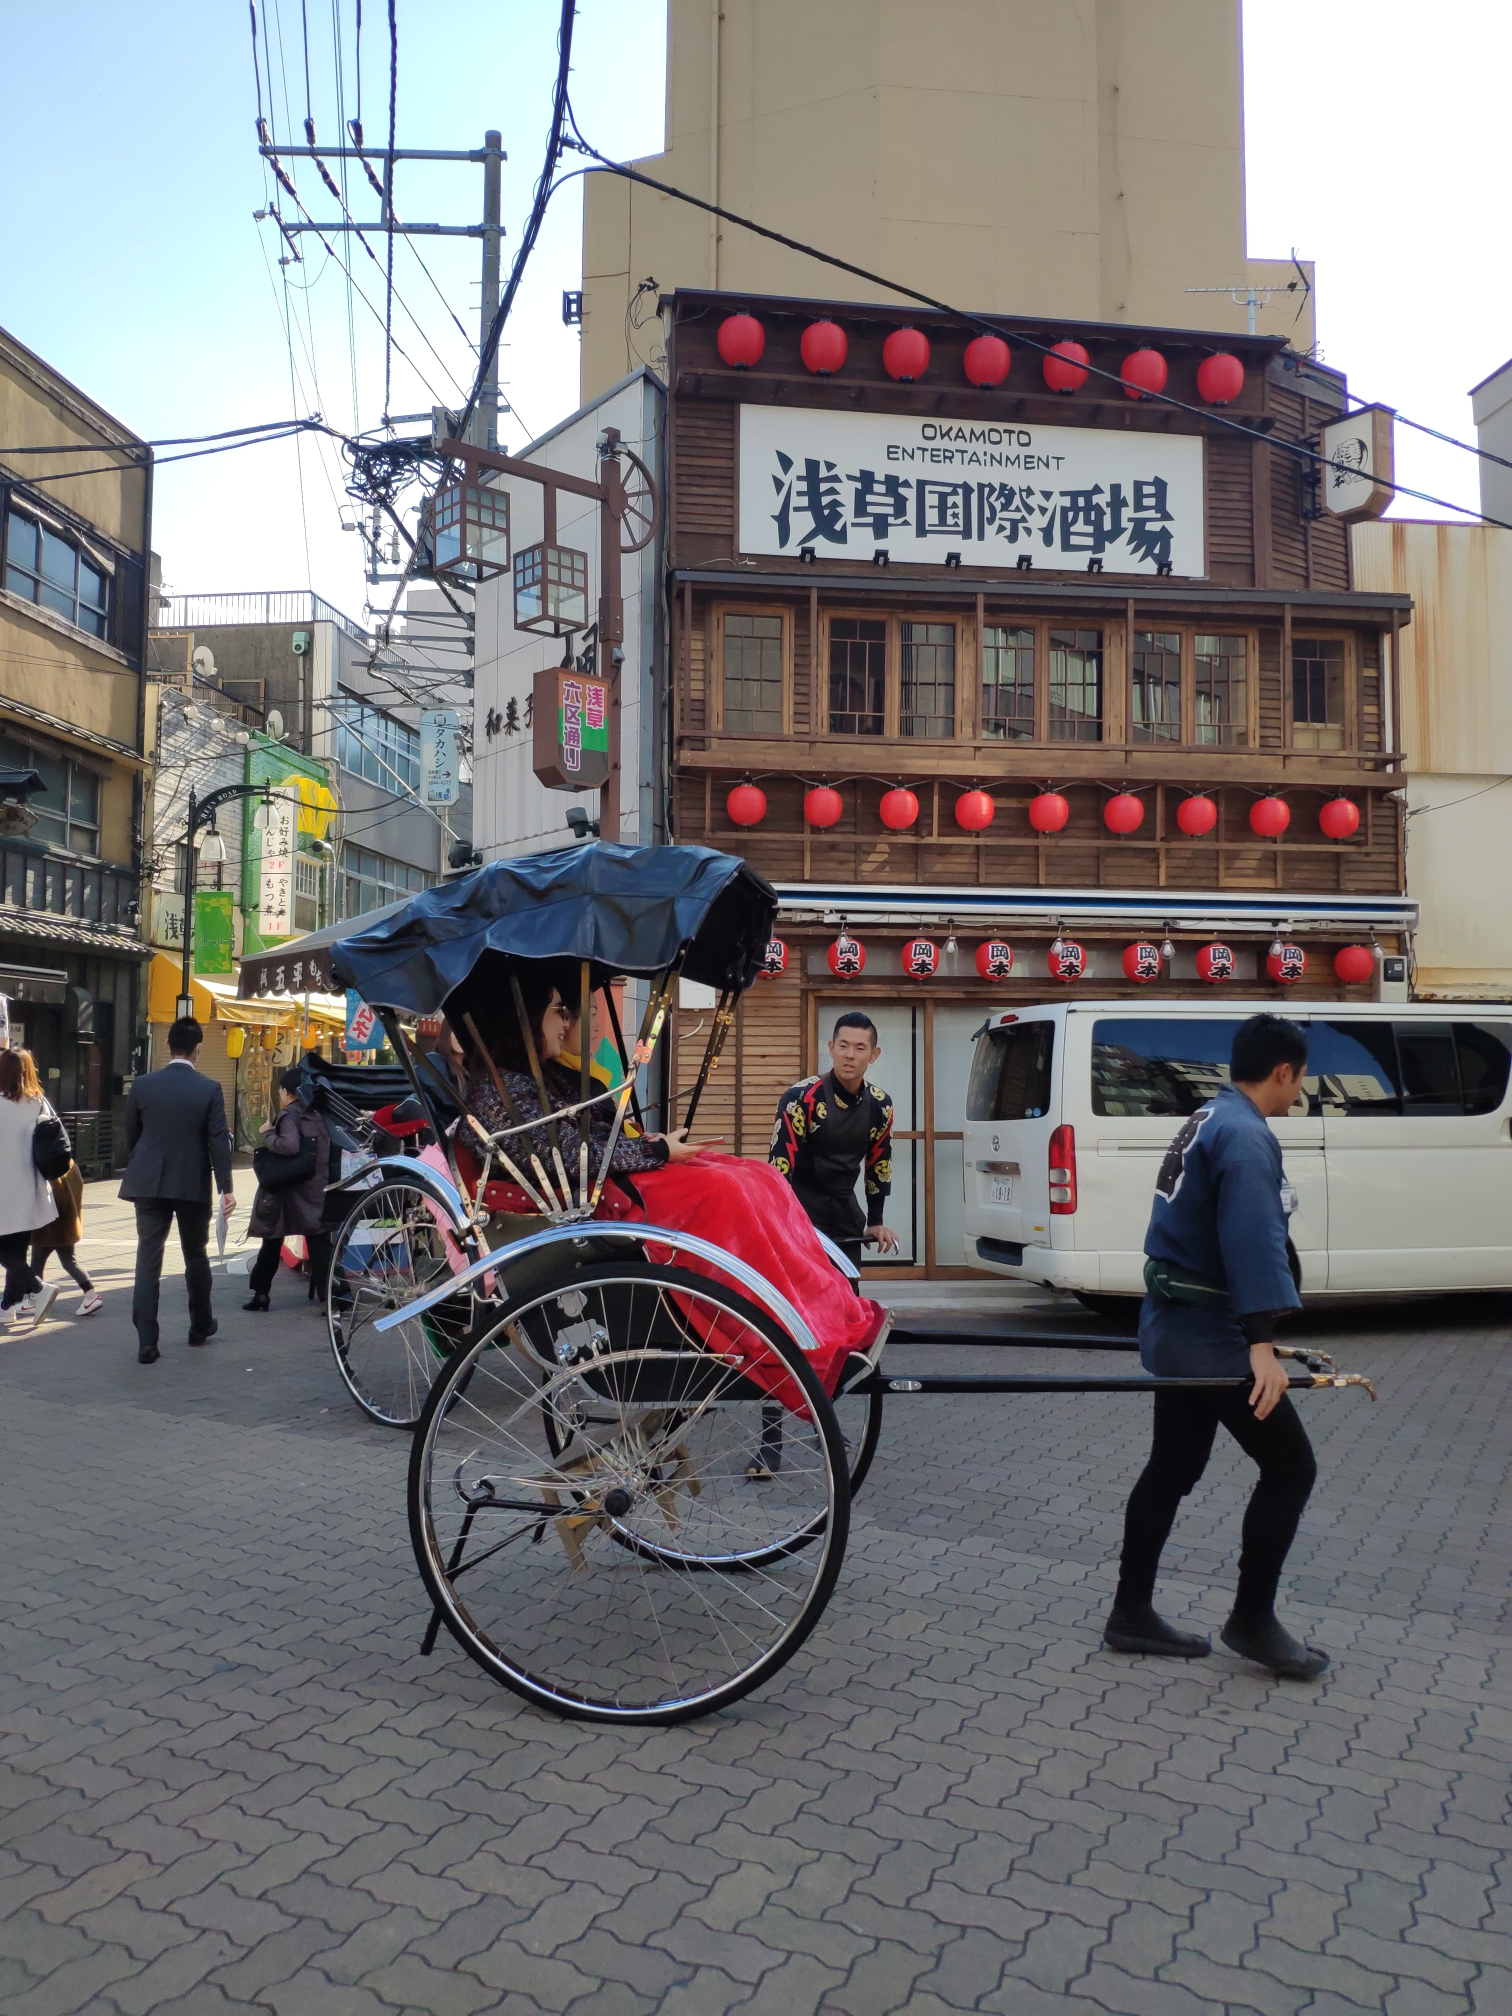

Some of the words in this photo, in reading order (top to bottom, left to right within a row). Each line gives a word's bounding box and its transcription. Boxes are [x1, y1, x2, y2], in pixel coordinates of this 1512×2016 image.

[921, 423, 1032, 448] OKAMOTO
[770, 449, 1175, 564] 浅草国際酒場
[586, 685, 605, 730] 浅草
[562, 680, 582, 772] 六区通り
[433, 728, 447, 769] タカハシ
[217, 788, 238, 802] ROAD
[265, 826, 276, 857] んじゃ
[278, 815, 290, 858] お好み焼
[269, 860, 285, 870] 2F
[263, 878, 276, 917] もつ煮
[268, 921, 283, 931] 1F
[835, 941, 860, 973] 岡本
[909, 942, 935, 975] 岡本
[986, 943, 1011, 977] 岡本
[1057, 944, 1081, 977] 岡本
[1134, 945, 1158, 978] 岡本
[1207, 946, 1232, 979] 岡本
[1278, 946, 1304, 979] 岡本
